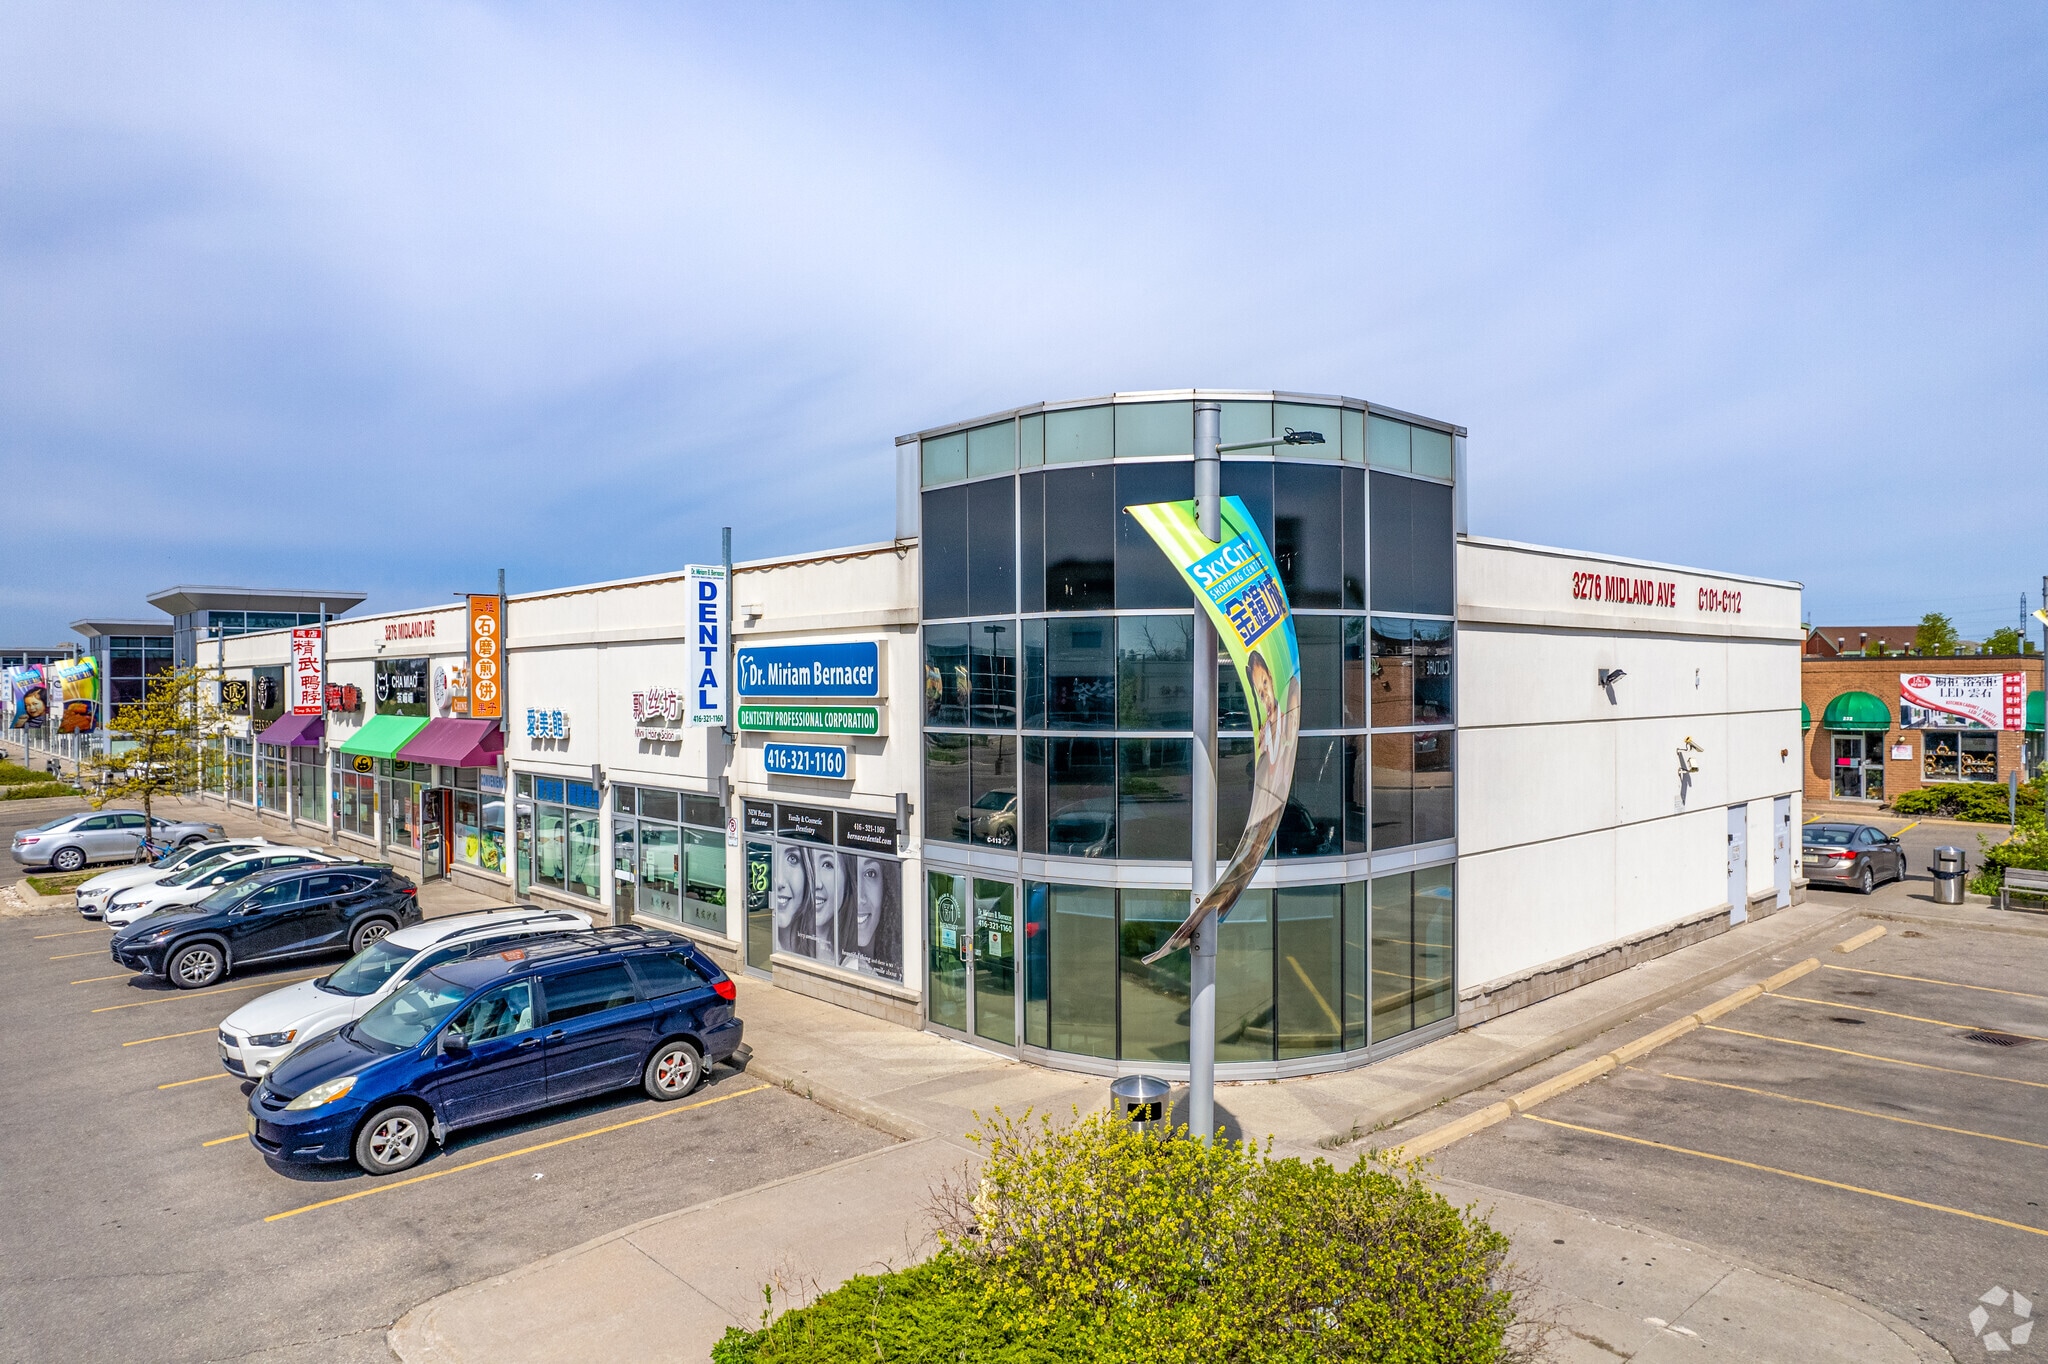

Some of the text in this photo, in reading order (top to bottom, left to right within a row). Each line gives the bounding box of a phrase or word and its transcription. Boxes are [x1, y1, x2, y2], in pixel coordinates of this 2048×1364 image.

[1193, 540, 1254, 586] SKYCITY
[1209, 572, 1243, 599] SHOPPING
[1572, 571, 1742, 613] 3276 MIDLAND AVE C101-C112
[385, 620, 436, 640] 3276 MIDLAND AVE
[698, 581, 718, 710] DENTAL
[750, 661, 874, 686] Dr. Miriam Bernacer
[1940, 688, 1964, 698] LED
[693, 714, 724, 723] 416-321-1160
[741, 711, 875, 729] DENTISTRY PROFESSIONAL CORPORATION
[767, 749, 842, 773] 416-321-1160
[796, 824, 816, 836] Dentistry
[805, 816, 823, 826] Cosmetic
[846, 832, 892, 846] bernacerdental.com
[978, 920, 1013, 933] 416-321-1160
